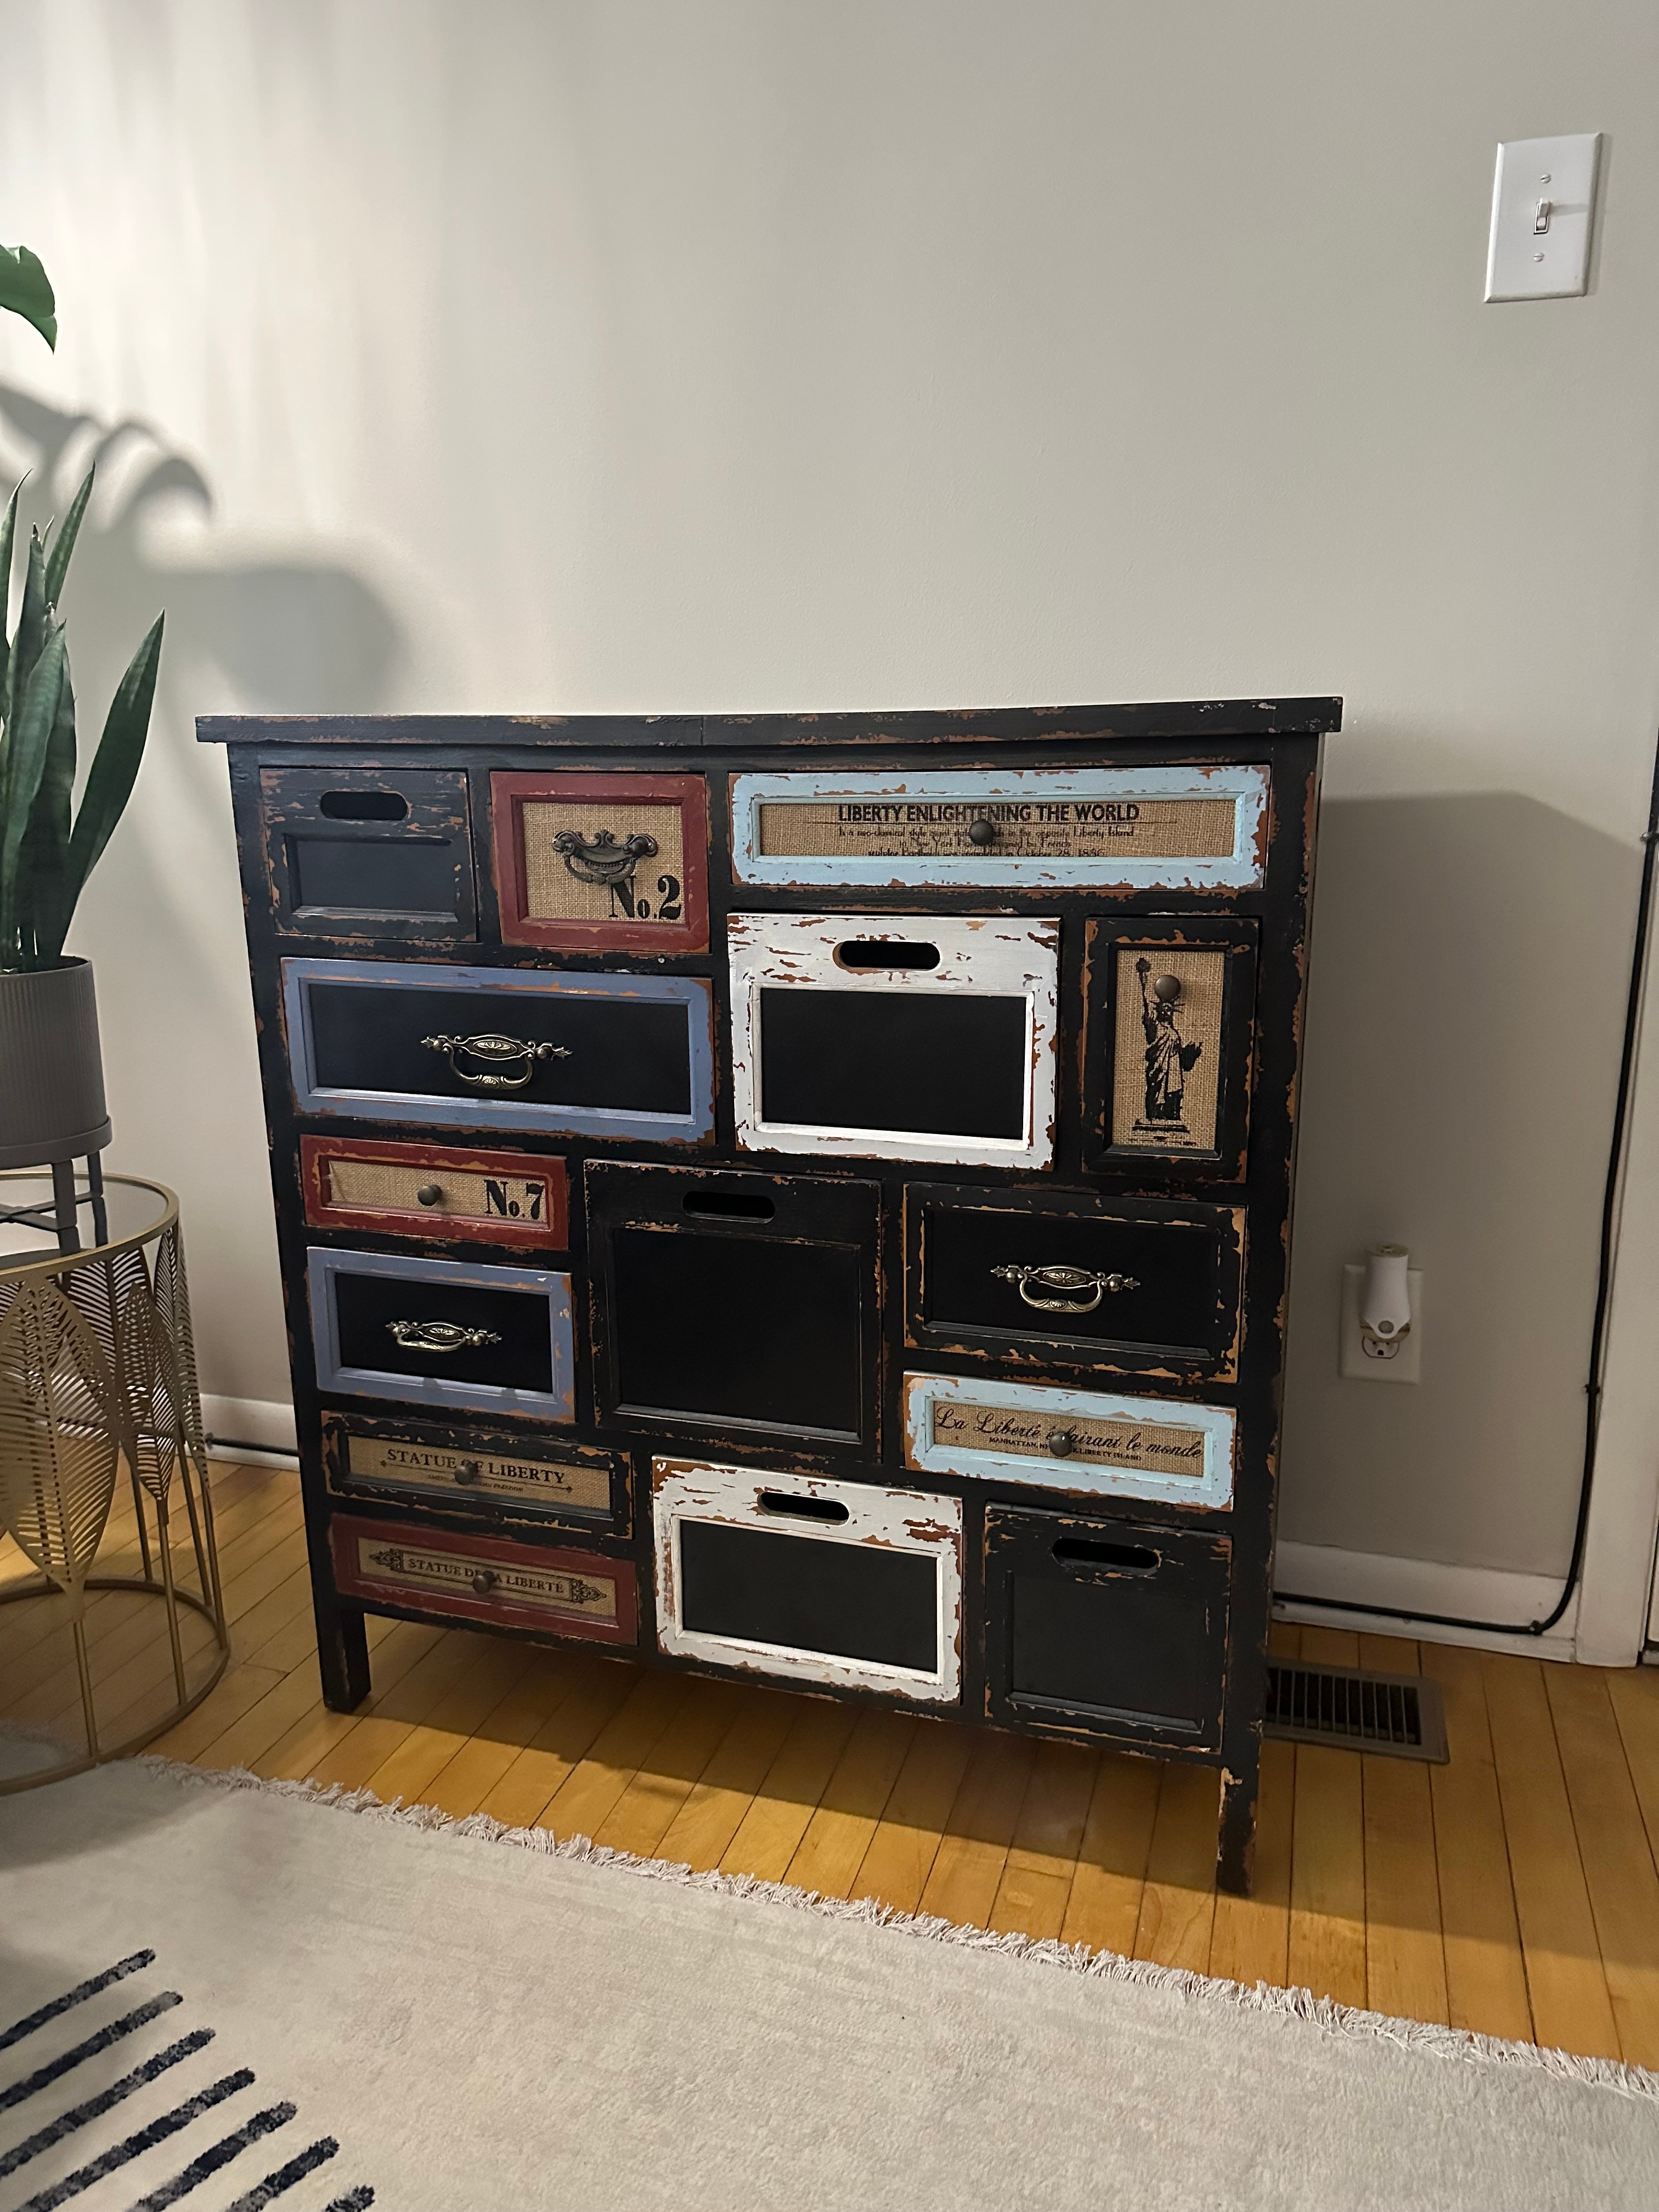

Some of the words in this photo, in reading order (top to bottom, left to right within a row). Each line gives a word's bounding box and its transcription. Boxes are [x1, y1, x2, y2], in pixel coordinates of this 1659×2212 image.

[839, 805, 902, 822] LIBERTY
[906, 804, 1031, 822] ENLIGHTENING
[1036, 804, 1070, 821] THE
[1074, 804, 1139, 821] WORLD
[1074, 826, 1104, 840] Liberty
[608, 874, 681, 921] No.2
[483, 1179, 545, 1220] No.7
[934, 1406, 969, 1430] La
[973, 1410, 1042, 1438] Liberté
[1126, 1432, 1143, 1451] le
[1146, 1440, 1203, 1459] monde
[387, 1448, 457, 1469] STATUE
[488, 1462, 565, 1484] LIBERTY
[409, 1558, 462, 1576] STATUE
[507, 1575, 564, 1593] LIBERTÉ
